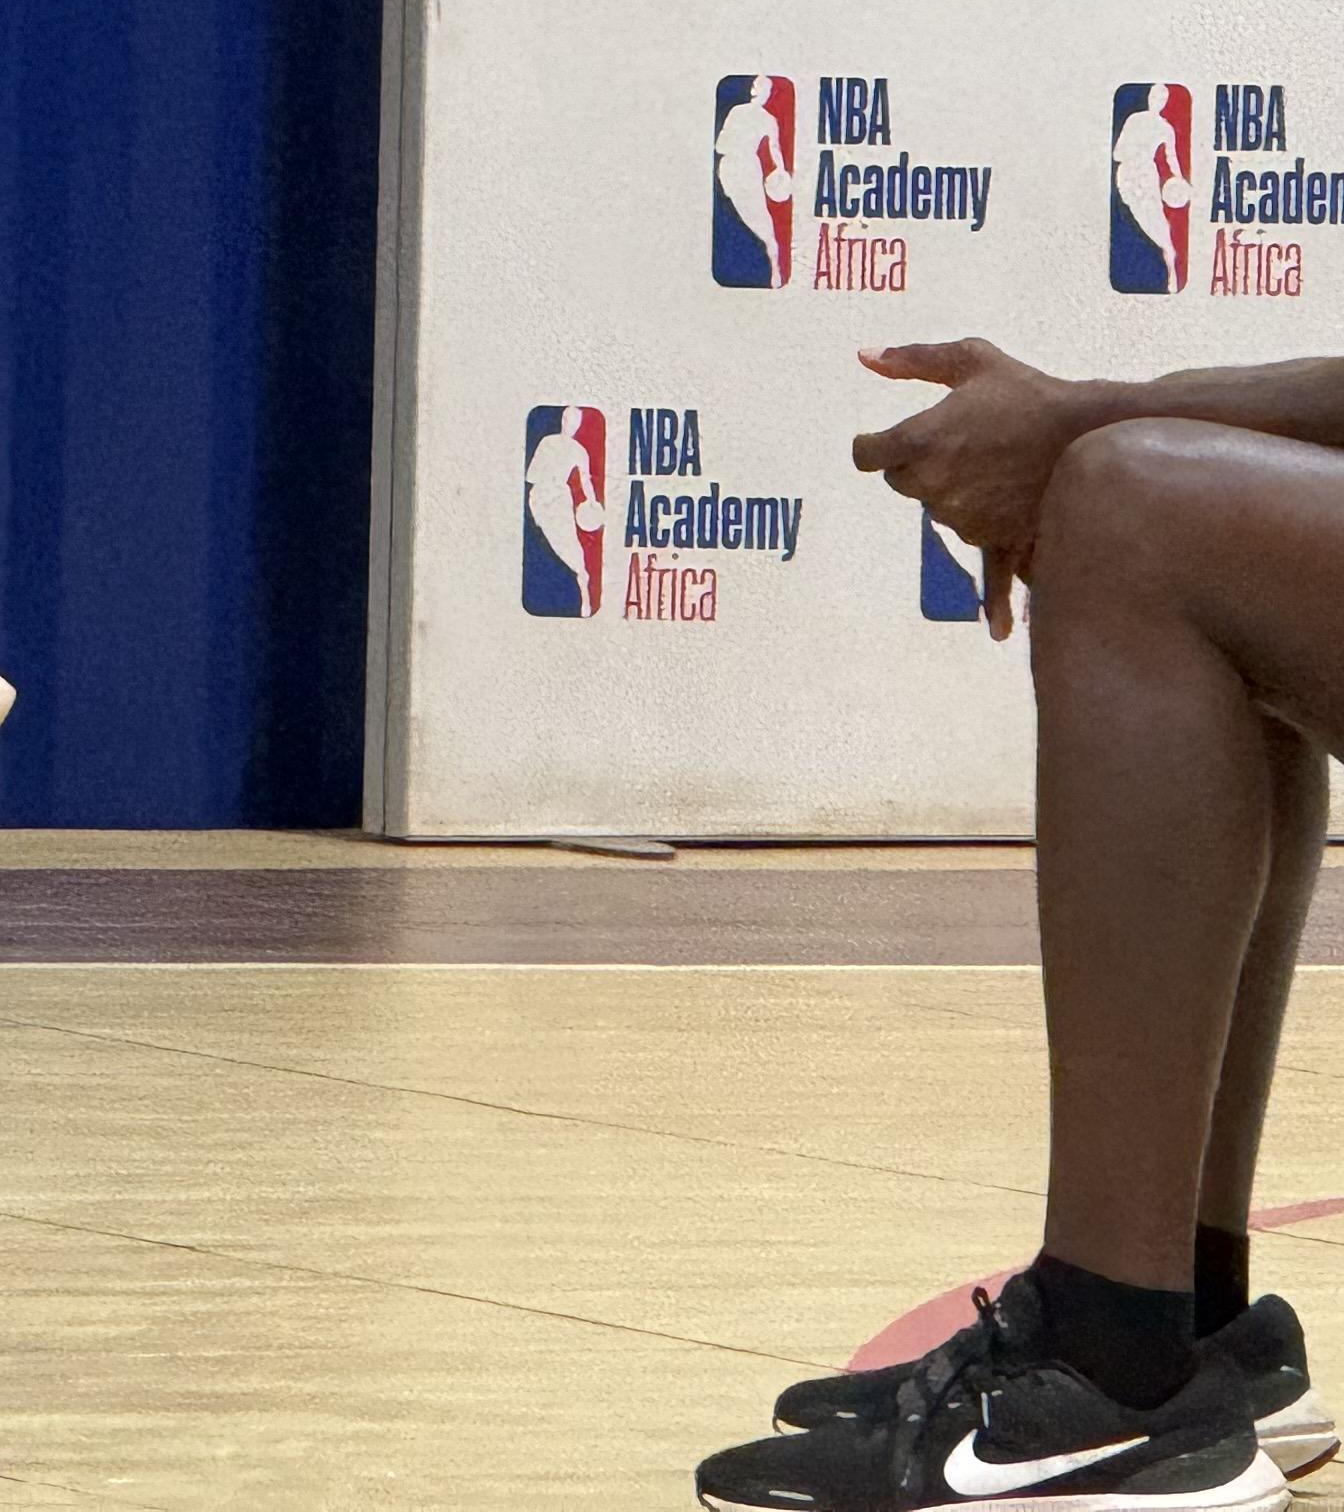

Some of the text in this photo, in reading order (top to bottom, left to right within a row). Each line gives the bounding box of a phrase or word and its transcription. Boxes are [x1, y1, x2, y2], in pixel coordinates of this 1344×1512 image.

[816, 76, 890, 146] NBA
[1212, 84, 1287, 152] NBA
[813, 149, 992, 231] Academy
[812, 223, 909, 294] Africa
[1209, 229, 1304, 297] Africa
[627, 407, 702, 476] NBA
[623, 479, 802, 561] Academy
[622, 552, 719, 623] Africa
